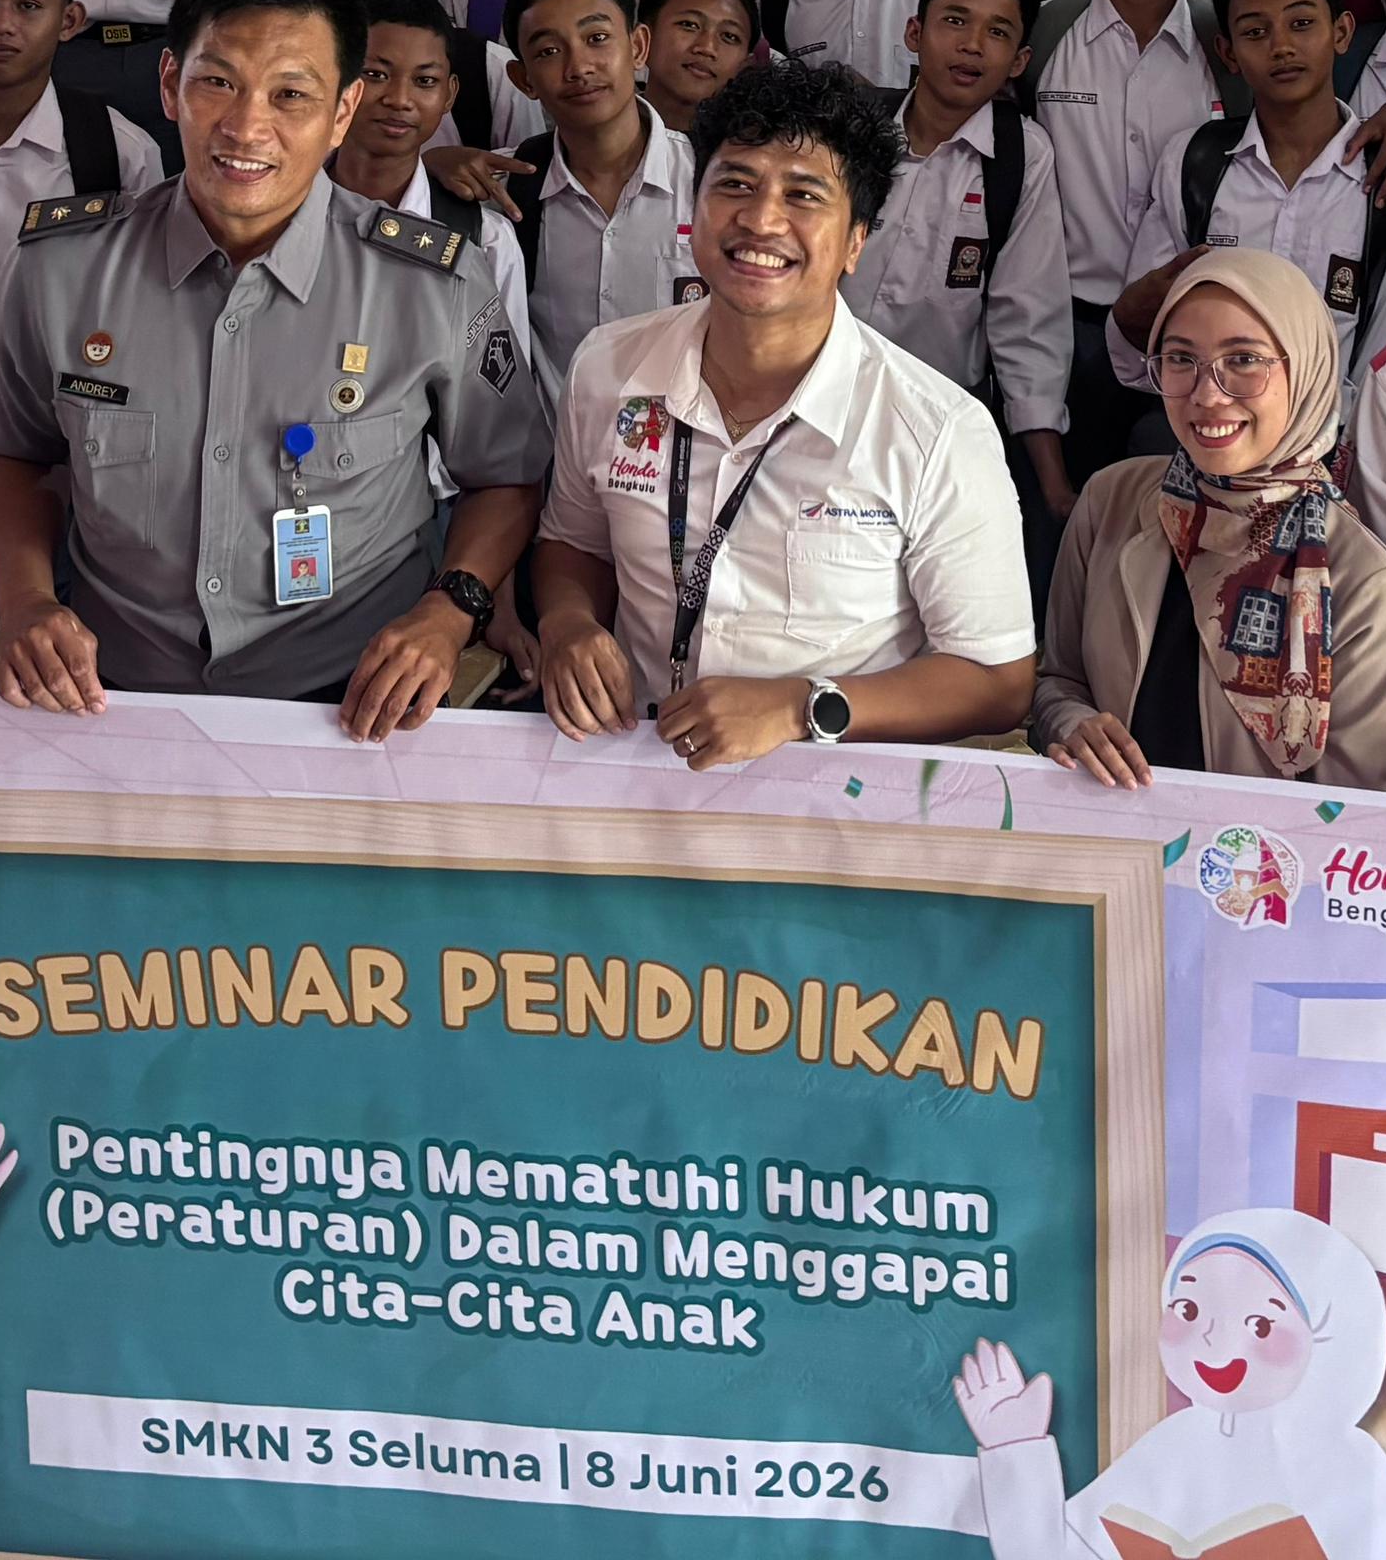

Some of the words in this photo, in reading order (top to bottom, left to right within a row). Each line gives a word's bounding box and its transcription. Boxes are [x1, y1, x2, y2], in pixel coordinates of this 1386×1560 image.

[70, 379, 118, 399] ANDREY
[608, 477, 655, 493] Bengkulu
[609, 456, 660, 478] Honda
[824, 507, 857, 518] ASTRA
[441, 948, 1044, 1100] PENDIDIKAN
[58, 1124, 405, 1200] Pentingnya
[426, 1146, 739, 1212] Mematuhi
[765, 1166, 989, 1234] Hukum
[47, 1187, 422, 1263] (Peraturan)
[449, 1214, 638, 1273] Dalam
[663, 1229, 1008, 1306] Menggapai
[282, 1268, 576, 1337] Cita-Cita
[595, 1291, 757, 1349] Anak
[141, 1417, 290, 1462] SMKN
[306, 1427, 333, 1465] 3
[348, 1429, 541, 1482] Seluma
[586, 1450, 615, 1488] 8
[630, 1453, 737, 1496] Juni
[754, 1460, 889, 1503] 2026
